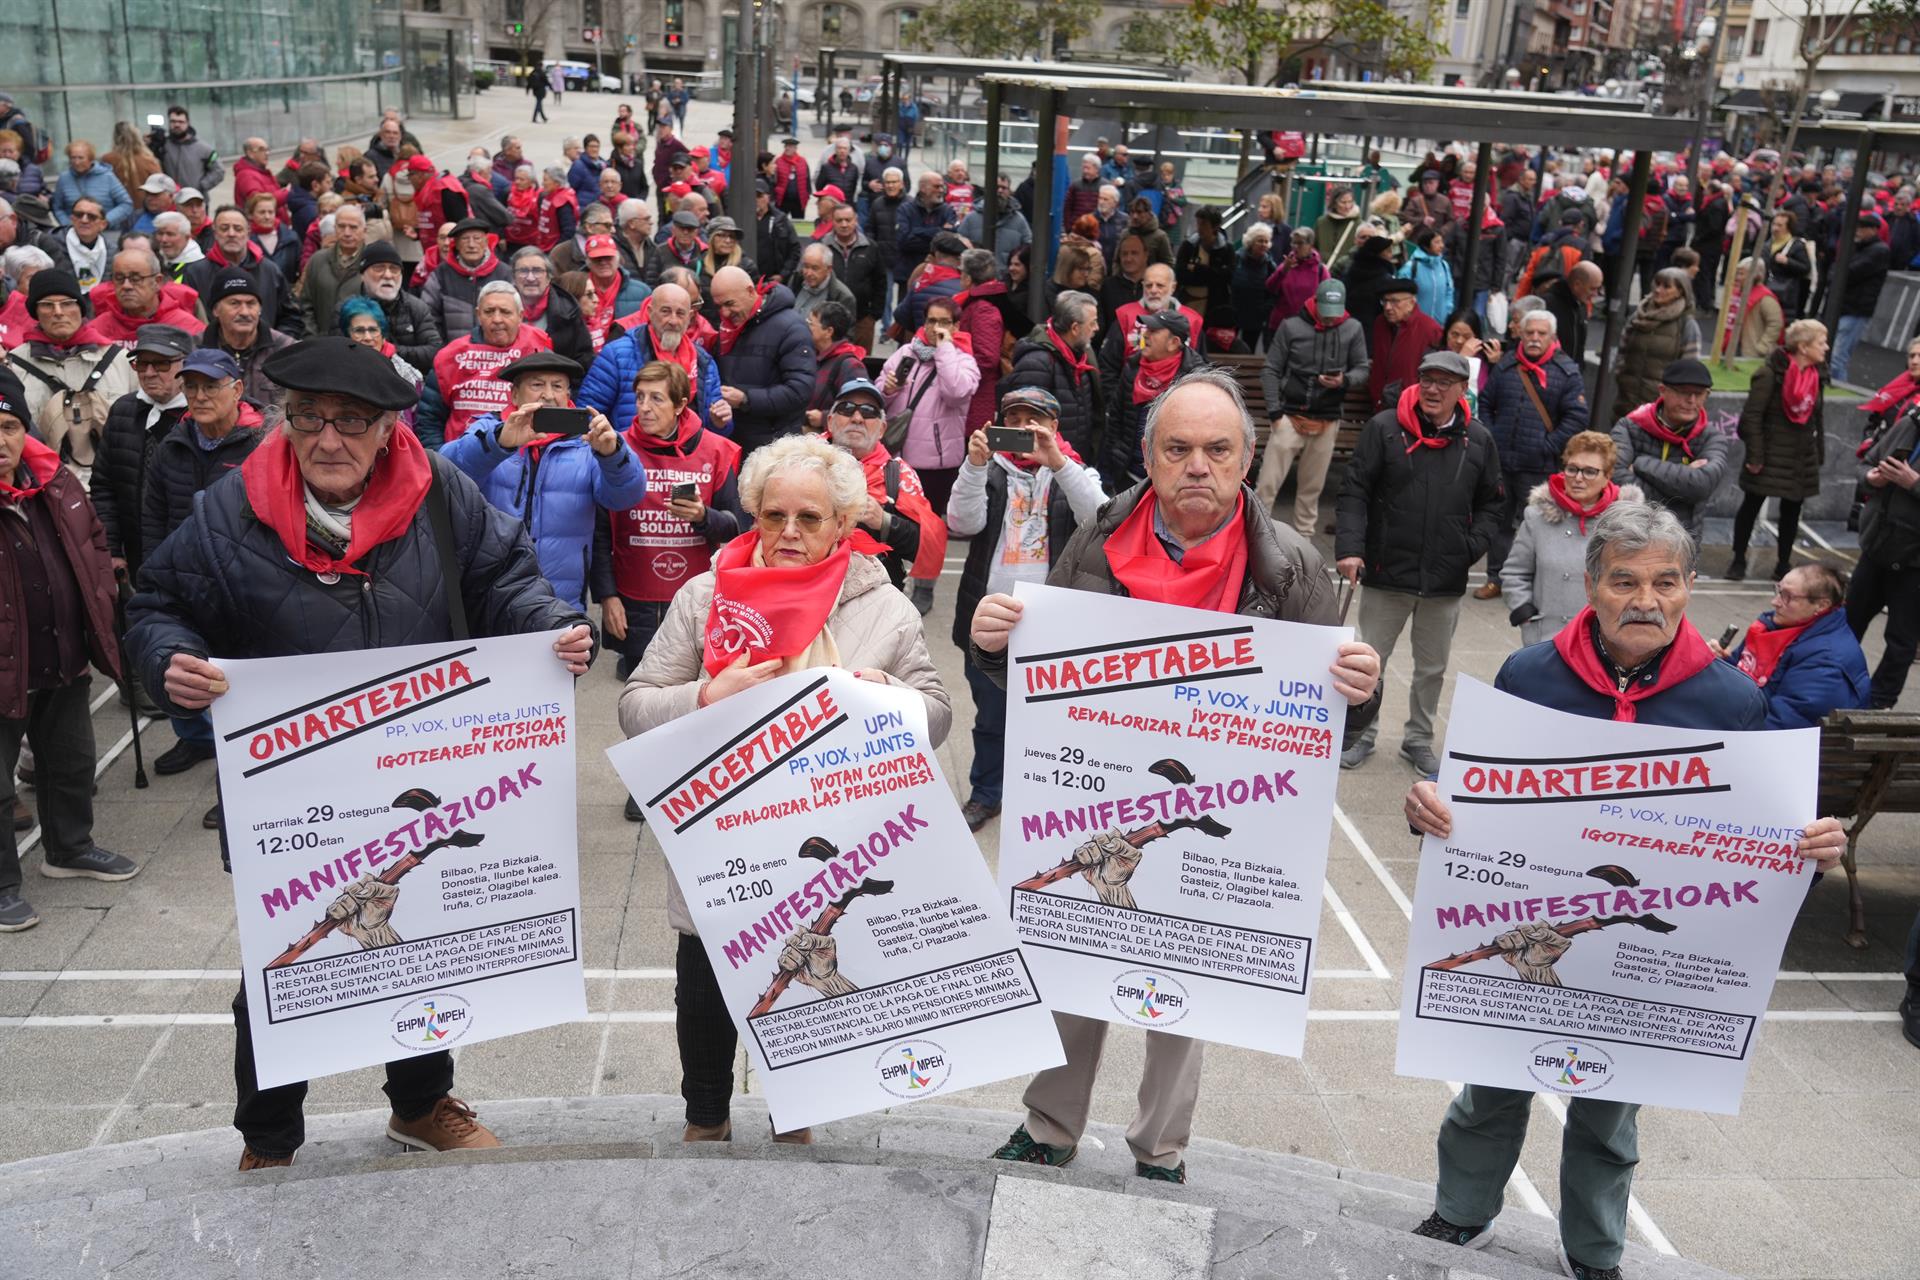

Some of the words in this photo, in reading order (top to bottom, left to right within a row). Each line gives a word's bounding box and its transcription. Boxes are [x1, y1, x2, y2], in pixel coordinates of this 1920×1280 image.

[460, 390, 508, 401] SOLDATA
[640, 523, 694, 534] SOLDAT
[740, 610, 772, 646] MOBIMENDUA
[754, 612, 774, 636] BIZKAIA
[1025, 637, 1255, 694] INACEPTABLE
[1173, 684, 1201, 704] PP,
[1208, 691, 1248, 709] VOX
[1253, 704, 1260, 714] y
[1265, 700, 1329, 724] JUNTS
[1278, 680, 1324, 700] UPN
[249, 660, 472, 760] ONARTEZINA
[386, 725, 408, 738] PP,
[412, 720, 448, 734] VOX,
[452, 714, 483, 728] UPN
[488, 712, 510, 722] eta
[514, 702, 560, 720] JUNTS
[864, 710, 902, 735] UPN
[471, 716, 565, 740] PENTSIOAK
[1068, 706, 1181, 736] REVALORIZAR
[1187, 725, 1221, 742] LAS
[1226, 730, 1331, 758] PENSIONES!
[1262, 721, 1332, 744] CONTRA
[377, 741, 486, 768] IGOTZEAREN
[493, 730, 566, 752] KONTRA!
[661, 688, 838, 825] INACEPTABLE
[788, 756, 814, 773] PP,
[815, 748, 849, 768] VOX
[854, 752, 860, 762] y
[863, 731, 916, 758] JUNTS
[1024, 748, 1056, 760] jueves
[1059, 746, 1084, 765] 29
[1087, 758, 1100, 768] de
[1103, 762, 1132, 773] enero
[867, 754, 930, 778] CONTRA
[1463, 756, 1710, 798] ONARTEZINA
[1023, 772, 1030, 780] a
[1032, 772, 1047, 783] las
[1051, 769, 1105, 792] 12:00
[716, 797, 811, 830] REVALORIZAR
[813, 789, 841, 809] LAS
[844, 767, 934, 801] PENSIONES!
[1021, 769, 1297, 841] MANIFESTAZIOAK
[252, 816, 304, 831] urtarrilak
[306, 804, 334, 824] 29
[338, 805, 390, 819] osteguna
[1600, 804, 1623, 819] PP,
[1630, 808, 1668, 825] VOX,
[1674, 815, 1711, 830] UPN
[1716, 822, 1743, 834] eta
[1748, 825, 1806, 842] JUNTS
[261, 762, 542, 919] MANIFESTAZIOAK
[1582, 828, 1706, 857] IGOTZEAREN
[1713, 848, 1803, 874] KONTRA!
[441, 867, 476, 878] Bilbao,
[480, 862, 499, 871] Pza
[502, 855, 544, 867] Bizkaia.
[441, 875, 490, 889] Donostia,
[494, 869, 524, 880] Ilunbe
[527, 862, 558, 873] kalea.
[697, 871, 726, 886] jueves
[725, 857, 746, 877] 29
[749, 863, 760, 872] de
[762, 858, 787, 870] enero
[1181, 862, 1229, 880] Donostia,
[1233, 871, 1265, 884] Ilunbe
[1268, 877, 1298, 888] kalea.
[1182, 850, 1217, 866] Bilbao,
[1221, 857, 1241, 869] Pza
[1244, 861, 1286, 875] Bizkaia.
[1445, 846, 1494, 863] urtarrilak
[1497, 850, 1526, 868] 29
[1529, 864, 1583, 878] osteguna
[442, 887, 484, 900] Gasteiz,
[488, 877, 529, 892] Olagibel
[532, 872, 560, 884] kalea.
[443, 901, 472, 911] Iruña,
[476, 896, 487, 905] C/
[490, 888, 538, 902] Plazaola.
[712, 897, 726, 906] las
[726, 878, 773, 903] 12:00
[723, 804, 929, 968] MANIFESTAZIOAK
[1179, 886, 1208, 899] Iruña,
[1212, 891, 1224, 900] C/
[1226, 893, 1275, 908] Plazaola.
[1180, 874, 1222, 890] Gasteiz,
[1226, 882, 1269, 896] Olagibel
[1271, 889, 1304, 901] kalea.
[866, 913, 900, 926] Bilbao,
[901, 907, 921, 917] Pza
[922, 896, 963, 911] Bizkaia.
[1436, 879, 1758, 929] MANIFESTAZIOAK
[871, 920, 918, 937] Donostia,
[918, 911, 949, 924] Ilunbe
[950, 903, 983, 916] kalea.
[877, 933, 918, 947] Gasteiz,
[918, 919, 959, 936] Olagibel
[959, 913, 992, 925] kalea.
[882, 946, 911, 958] Iruña,
[912, 940, 923, 950] C/
[925, 930, 972, 946] Plazaola.
[1618, 942, 1657, 956] Bilbao,
[1662, 949, 1684, 959] Pza
[1688, 953, 1734, 966] Bizkaia.
[273, 984, 328, 1001] -MEJORA
[330, 969, 403, 990] SUSTANCIAL
[406, 964, 422, 975] DE
[425, 960, 447, 971] LAS
[450, 946, 515, 966] PENSIONES
[518, 935, 564, 952] MINIMAS
[1614, 961, 1660, 976] Gasteiz,
[1665, 969, 1713, 982] Olagibel
[1716, 977, 1751, 987] kalea.
[1616, 951, 1669, 967] Donostia,
[1675, 961, 1710, 972] Ilunbe
[1714, 967, 1749, 977] kalea.
[1612, 970, 1643, 982] Iruña,
[1648, 976, 1662, 984] C/
[1664, 978, 1717, 992] Plazaola.
[1116, 985, 1144, 1000] EHPM
[1154, 992, 1183, 1008] MPEH
[396, 1016, 426, 1032] EHPM
[436, 1008, 465, 1024] MPEH
[1424, 1002, 1480, 1016] -PENSION
[1483, 1009, 1526, 1022] MINIMA
[1539, 1016, 1585, 1029] SALARIO
[1587, 1023, 1627, 1035] MINIMO
[1629, 1029, 1737, 1051] INTERPROFESIONAL
[881, 1063, 909, 1080] EHPM
[916, 1054, 944, 1071] MPEH
[1534, 1055, 1564, 1068] EHPM
[1576, 1060, 1607, 1074] MPEH
